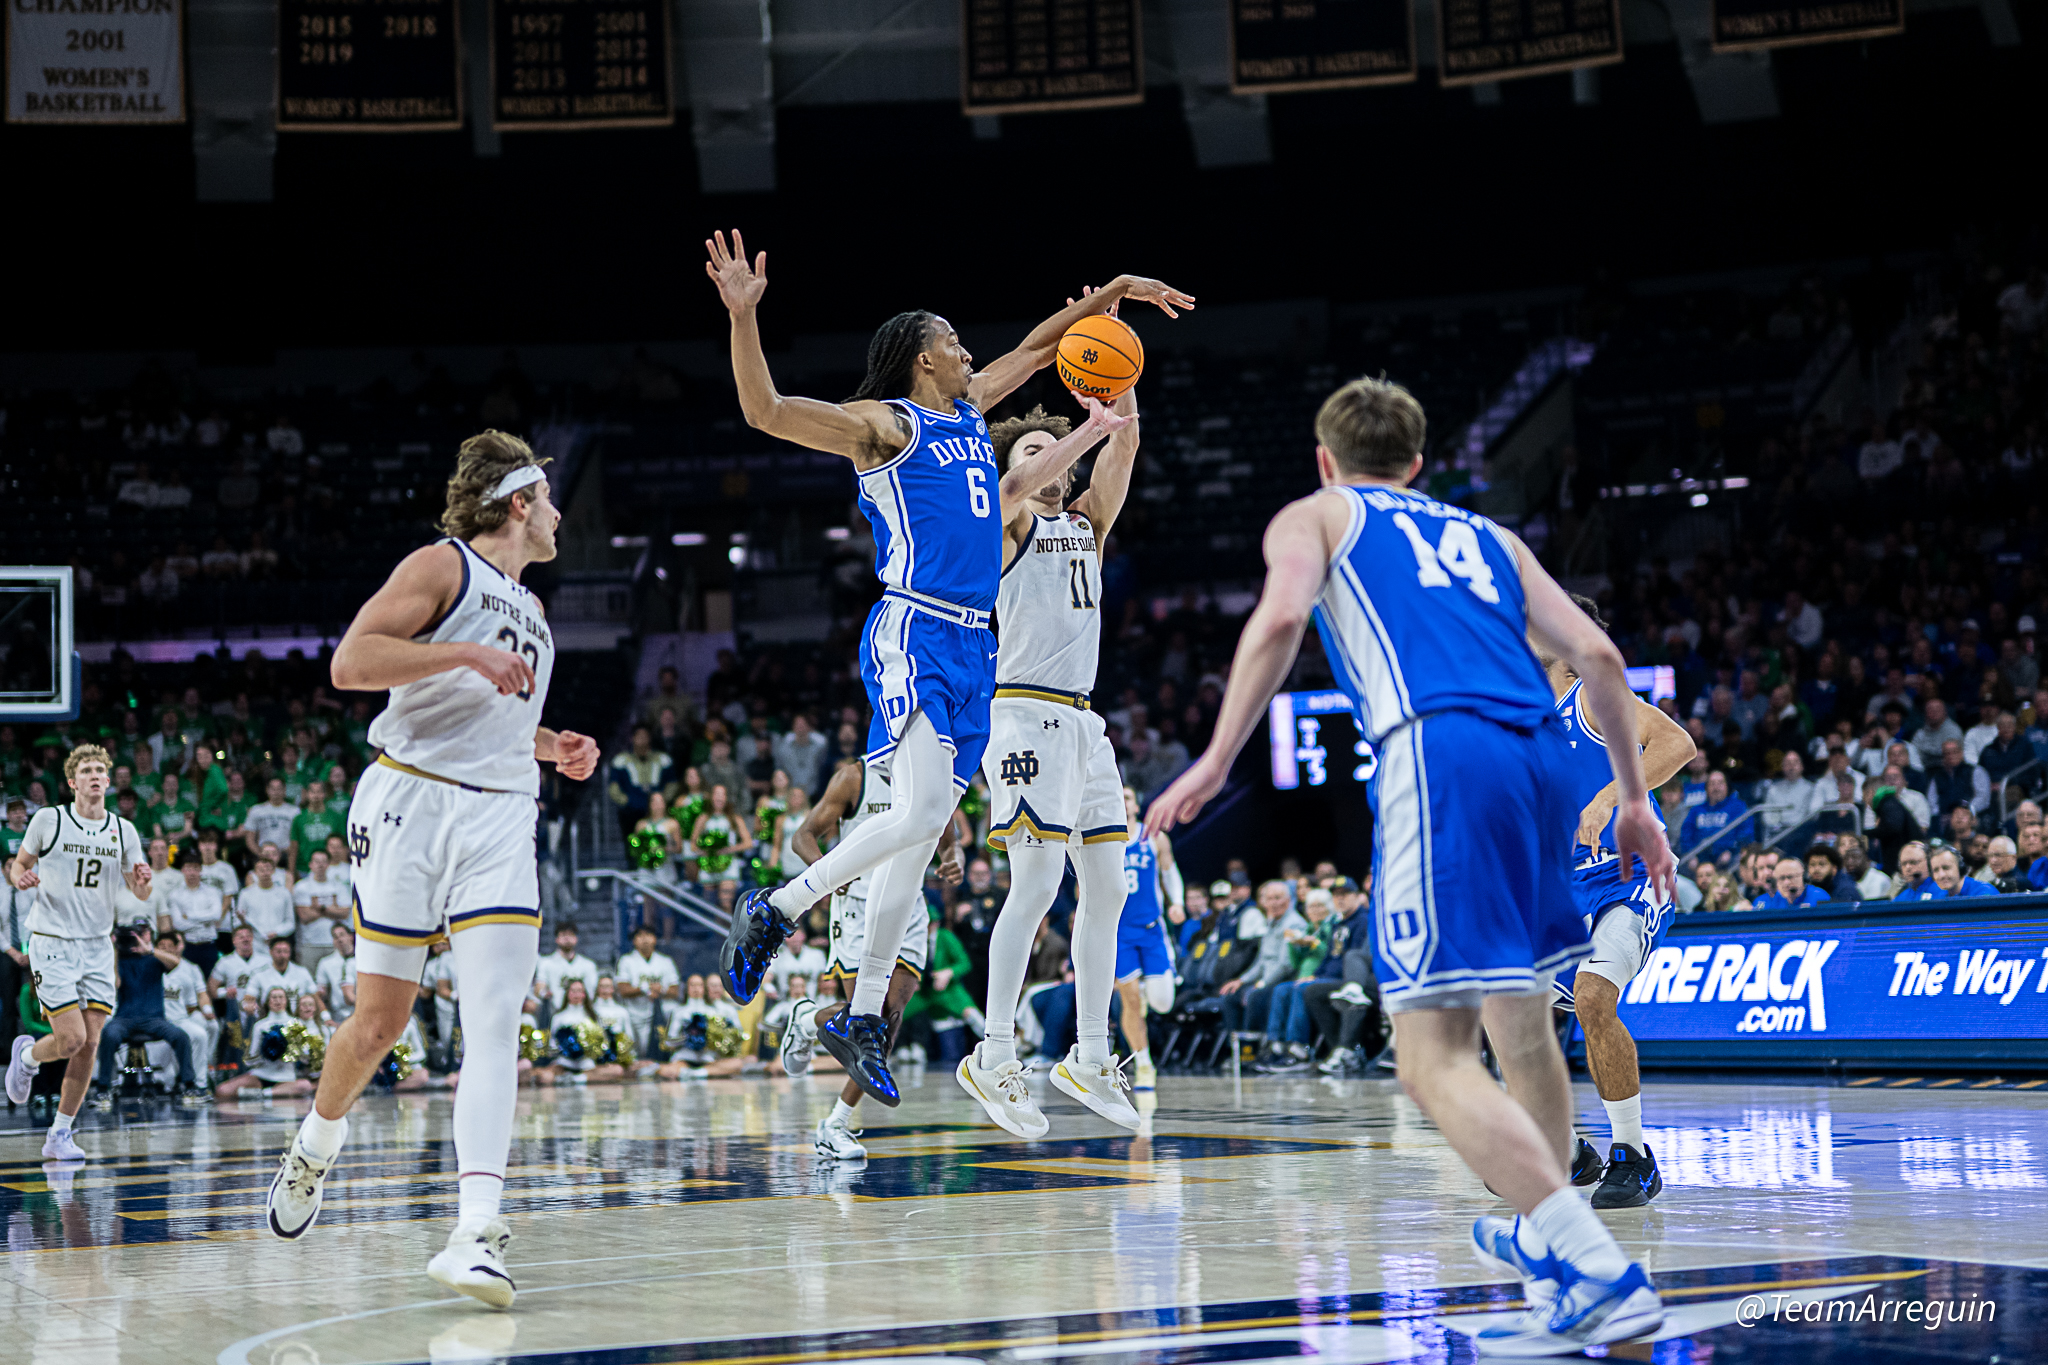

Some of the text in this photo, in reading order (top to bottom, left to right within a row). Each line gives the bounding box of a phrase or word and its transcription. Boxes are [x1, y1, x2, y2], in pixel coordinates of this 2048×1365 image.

[299, 14, 437, 38] 2015 2018
[511, 13, 563, 35] 1997
[66, 29, 125, 51] 2001
[513, 38, 647, 63] 2011 2012
[299, 42, 354, 65] 2019
[43, 68, 150, 88] WOMEN'S
[596, 65, 647, 88] 2014
[26, 92, 165, 112] BASKETBALL
[283, 96, 453, 118] WOMEN'S BASKETBALL
[501, 93, 667, 115] WOMEN'S BASKETBALL
[1060, 362, 1111, 394] Wilson
[928, 437, 996, 469] DUKE
[966, 467, 990, 518] 6
[1036, 536, 1096, 553] NOTRE DAME
[1392, 512, 1500, 604] 14
[1069, 559, 1095, 609] 11
[481, 592, 549, 649] NOTRE DAME
[867, 803, 892, 814] NOT
[63, 843, 118, 858] NOTRE DAME
[74, 858, 102, 888] 12
[1617, 945, 1712, 1005] IRE
[1888, 951, 1950, 997] The
[1953, 949, 2035, 1005] Way
[1736, 1006, 1806, 1033] .com
